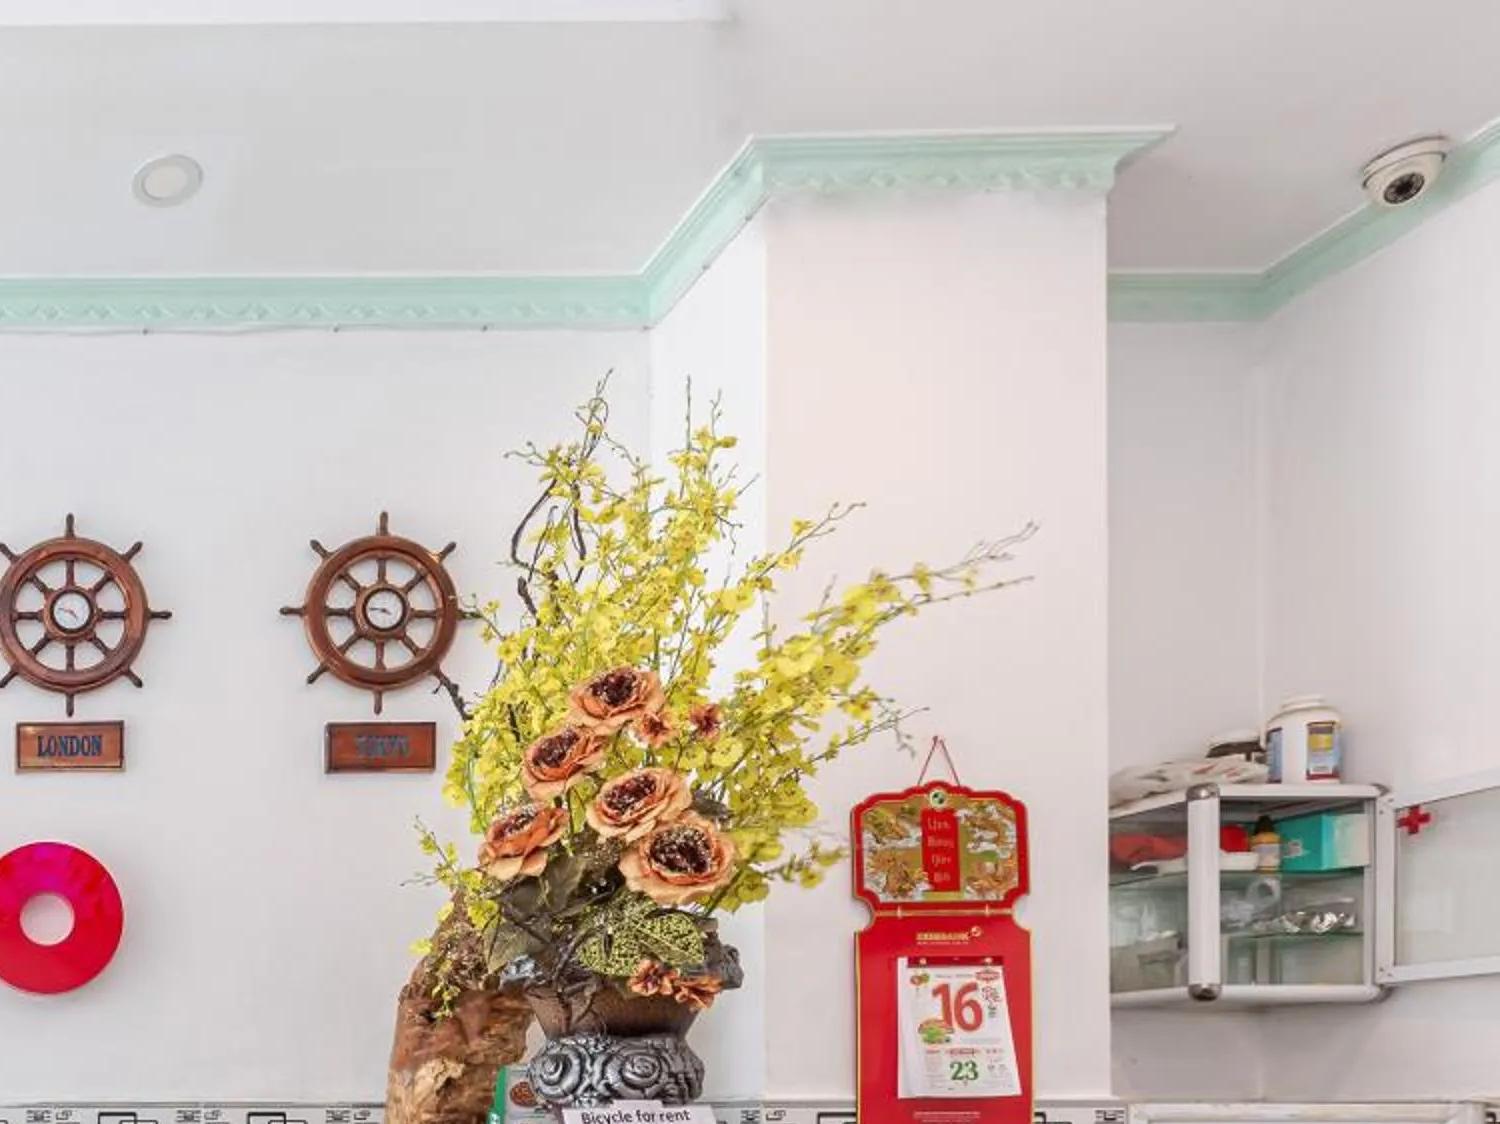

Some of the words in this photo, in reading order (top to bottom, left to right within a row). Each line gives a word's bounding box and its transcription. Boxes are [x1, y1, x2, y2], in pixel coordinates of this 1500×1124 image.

[37, 734, 102, 757] LONDON
[931, 982, 983, 1032] 16
[950, 1060, 979, 1081] 23
[636, 1110, 655, 1122] for
[659, 1109, 691, 1122] rent
